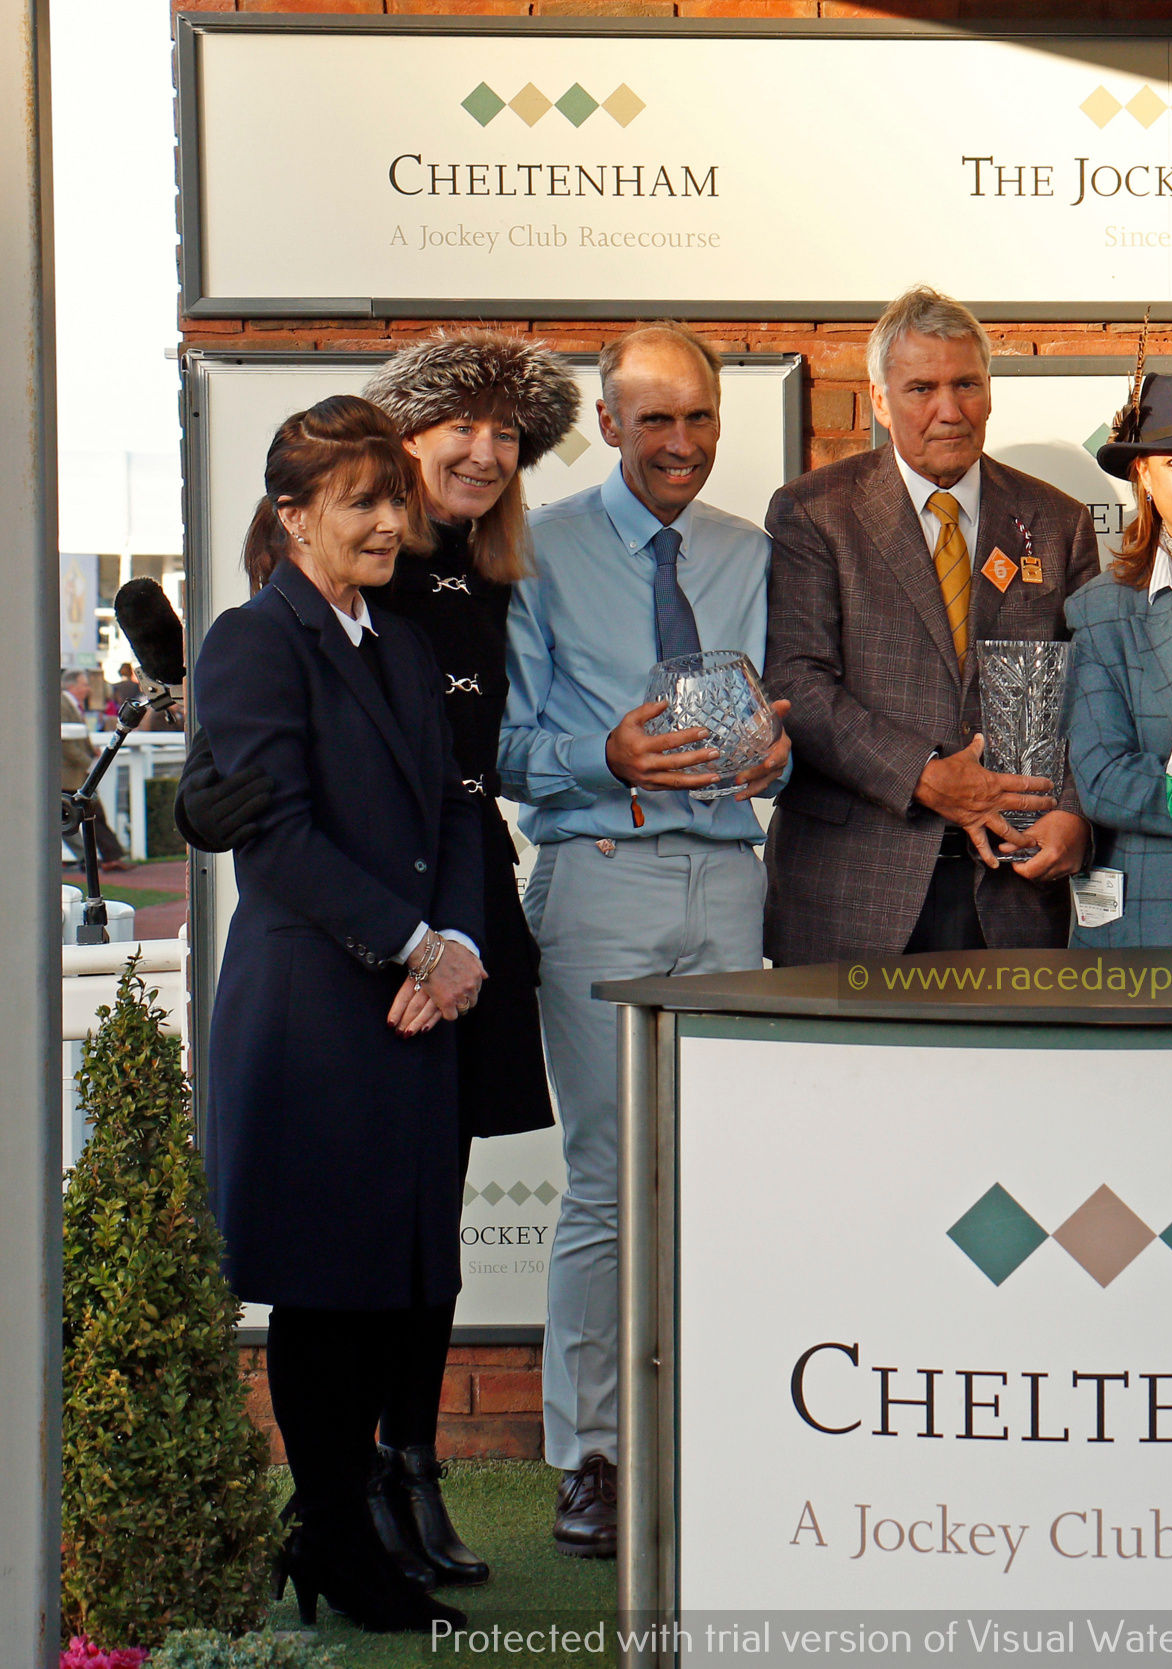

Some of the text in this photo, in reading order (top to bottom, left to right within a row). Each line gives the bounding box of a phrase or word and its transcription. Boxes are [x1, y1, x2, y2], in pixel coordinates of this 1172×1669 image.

[389, 154, 720, 198] CHELTENHAM
[961, 155, 1055, 197] THE
[389, 224, 721, 254] A Jockey Club Racecourse
[1104, 226, 1172, 248] Since
[461, 1226, 549, 1246] OCKEY
[468, 1260, 545, 1274] Since 1750
[789, 1500, 829, 1548] A
[849, 1503, 1030, 1574] Jockey
